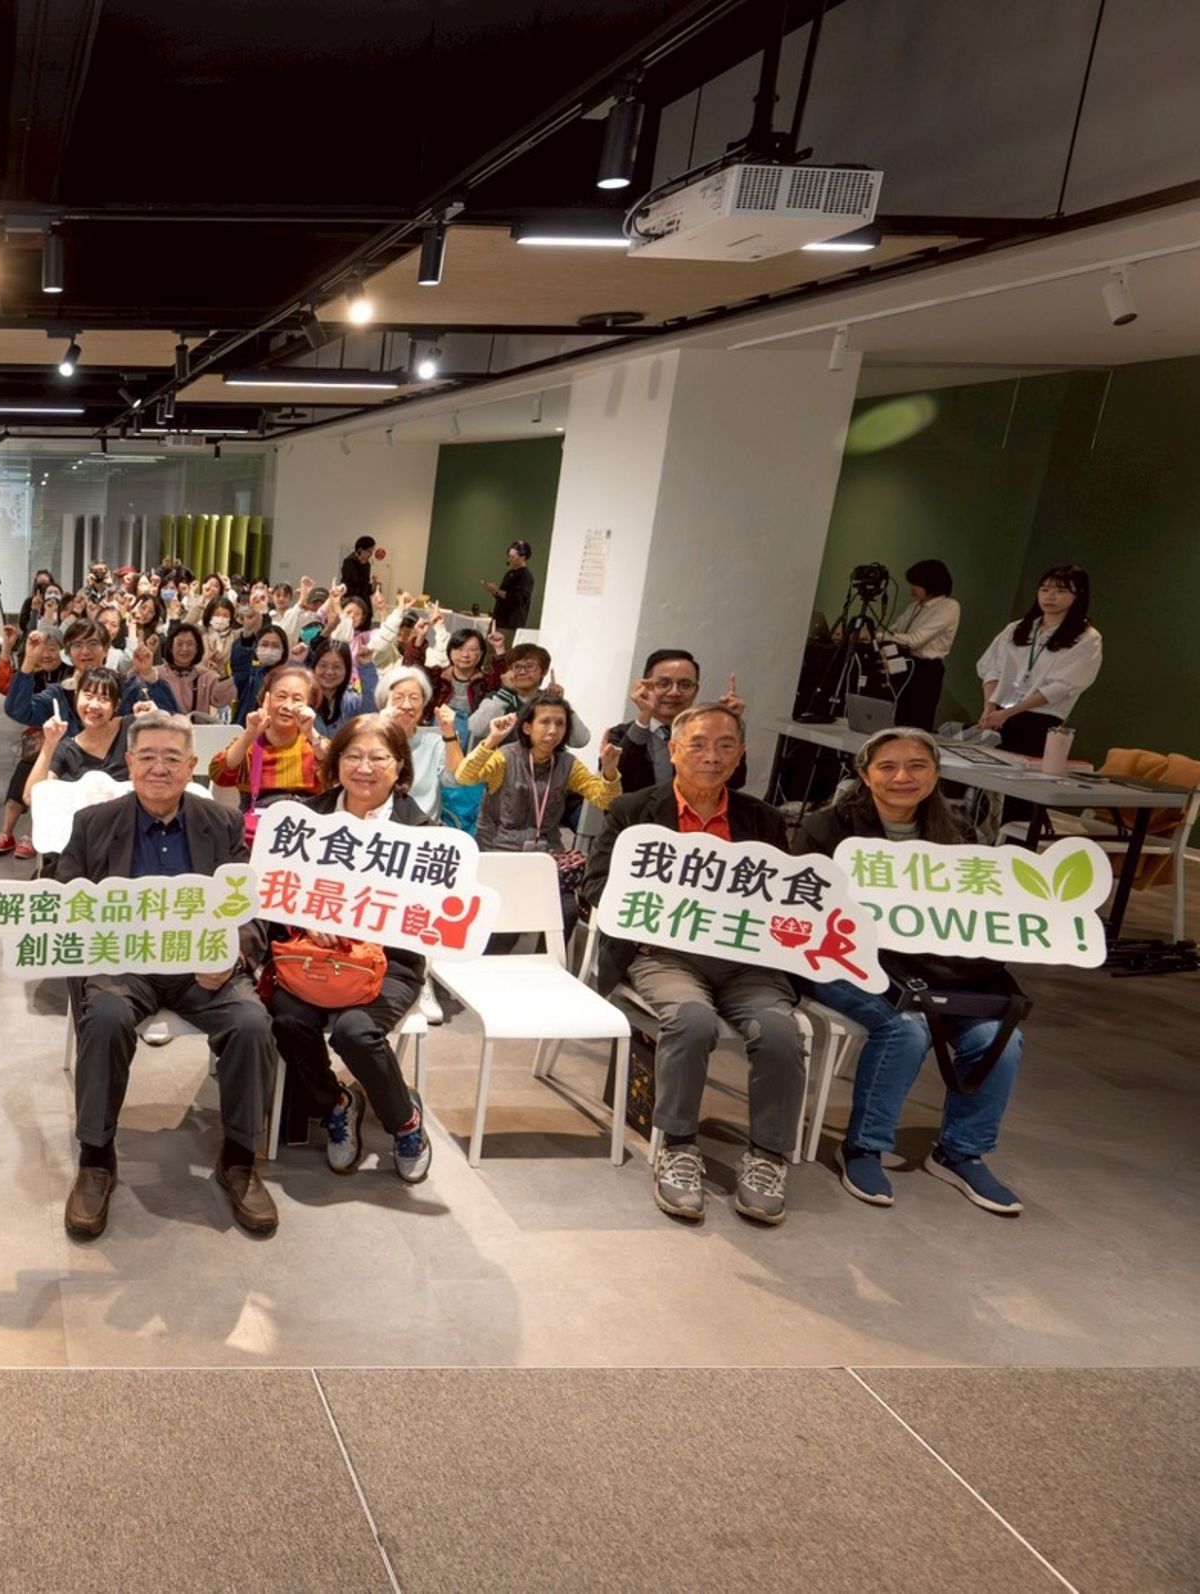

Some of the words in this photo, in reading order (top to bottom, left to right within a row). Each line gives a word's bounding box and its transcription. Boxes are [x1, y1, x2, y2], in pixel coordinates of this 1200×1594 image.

[268, 816, 461, 889] 飲食知識
[630, 840, 832, 912] 我的飲食
[850, 849, 1004, 896] 植化素
[259, 870, 398, 933] 我最行
[617, 890, 767, 953] 我作主
[16, 928, 228, 967] 創造美味關係
